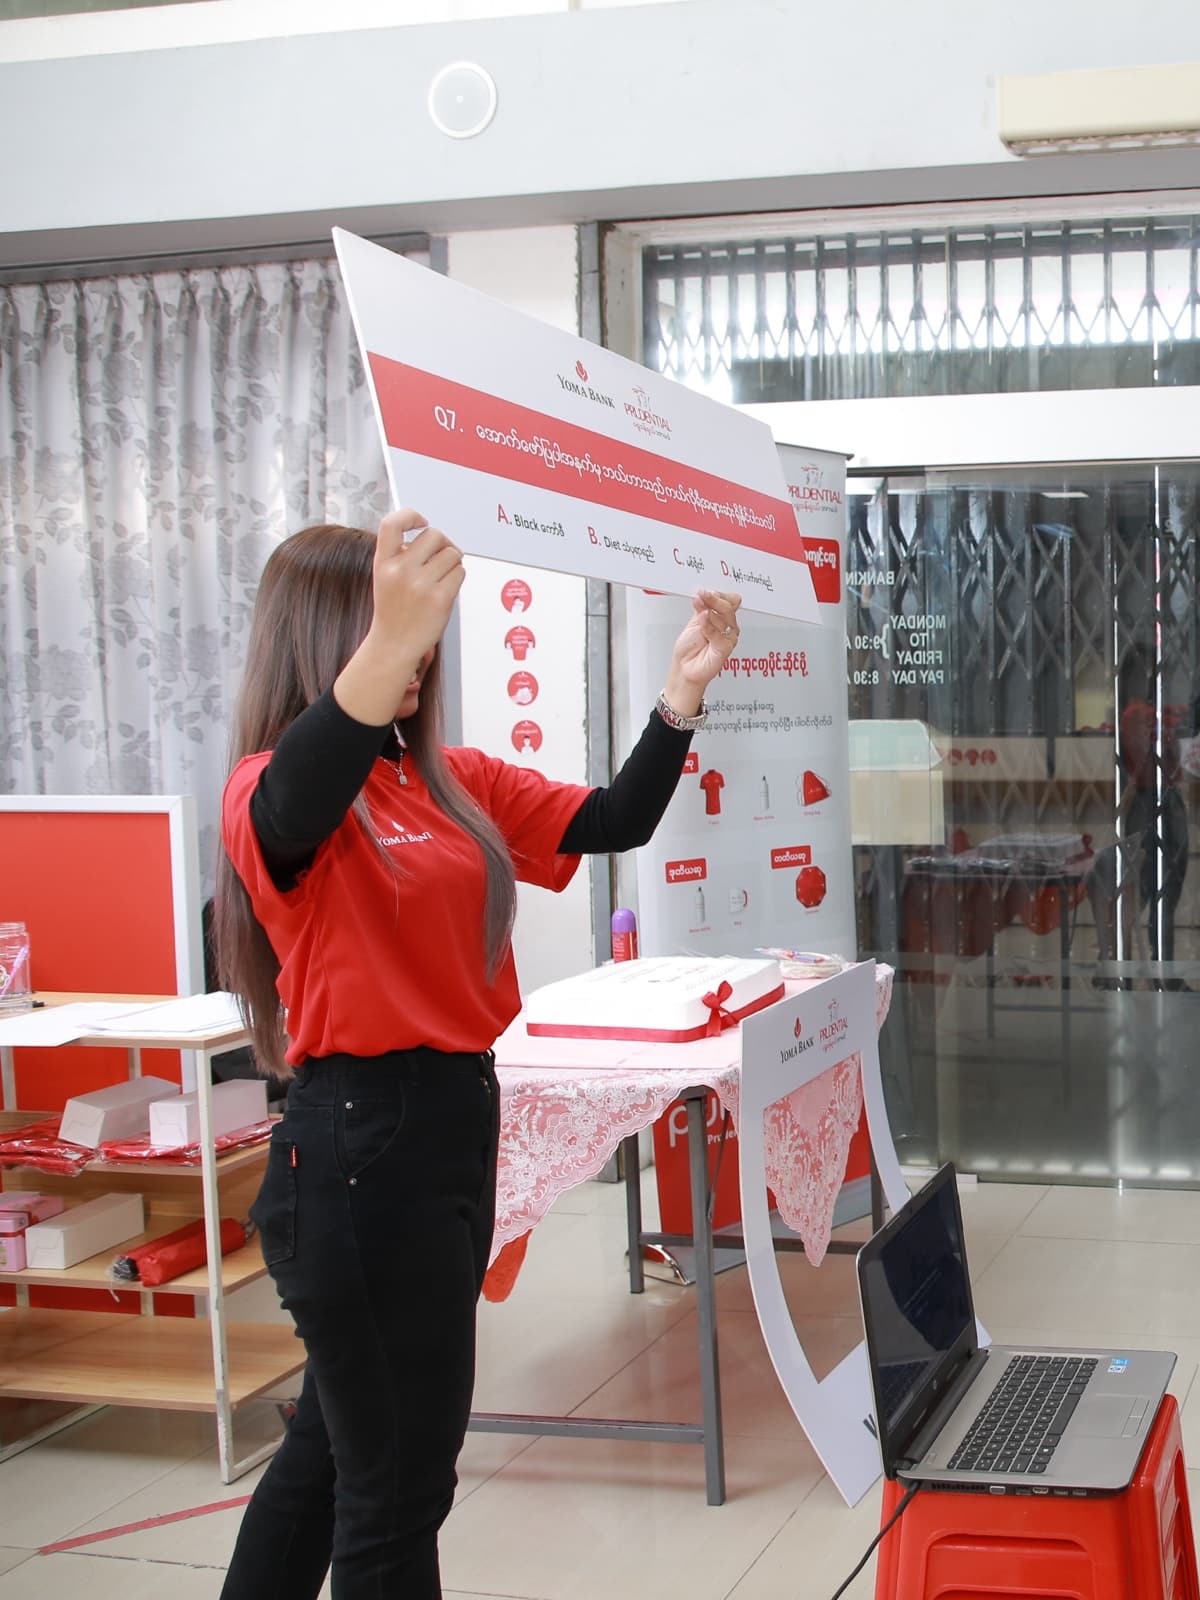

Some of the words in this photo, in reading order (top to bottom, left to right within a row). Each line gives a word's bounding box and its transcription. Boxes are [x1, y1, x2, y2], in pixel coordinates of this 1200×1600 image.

[557, 374, 587, 398] YOMA
[588, 387, 616, 409] BANK
[624, 402, 673, 433] PRUDENTIAL
[497, 503, 513, 526] A.
[514, 514, 540, 532] Black
[587, 526, 602, 546] B.
[604, 535, 621, 550] Diet
[819, 1016, 849, 1042] PRUDENTIAL
[779, 1045, 798, 1065] YOMA
[798, 1037, 815, 1054] BANK
